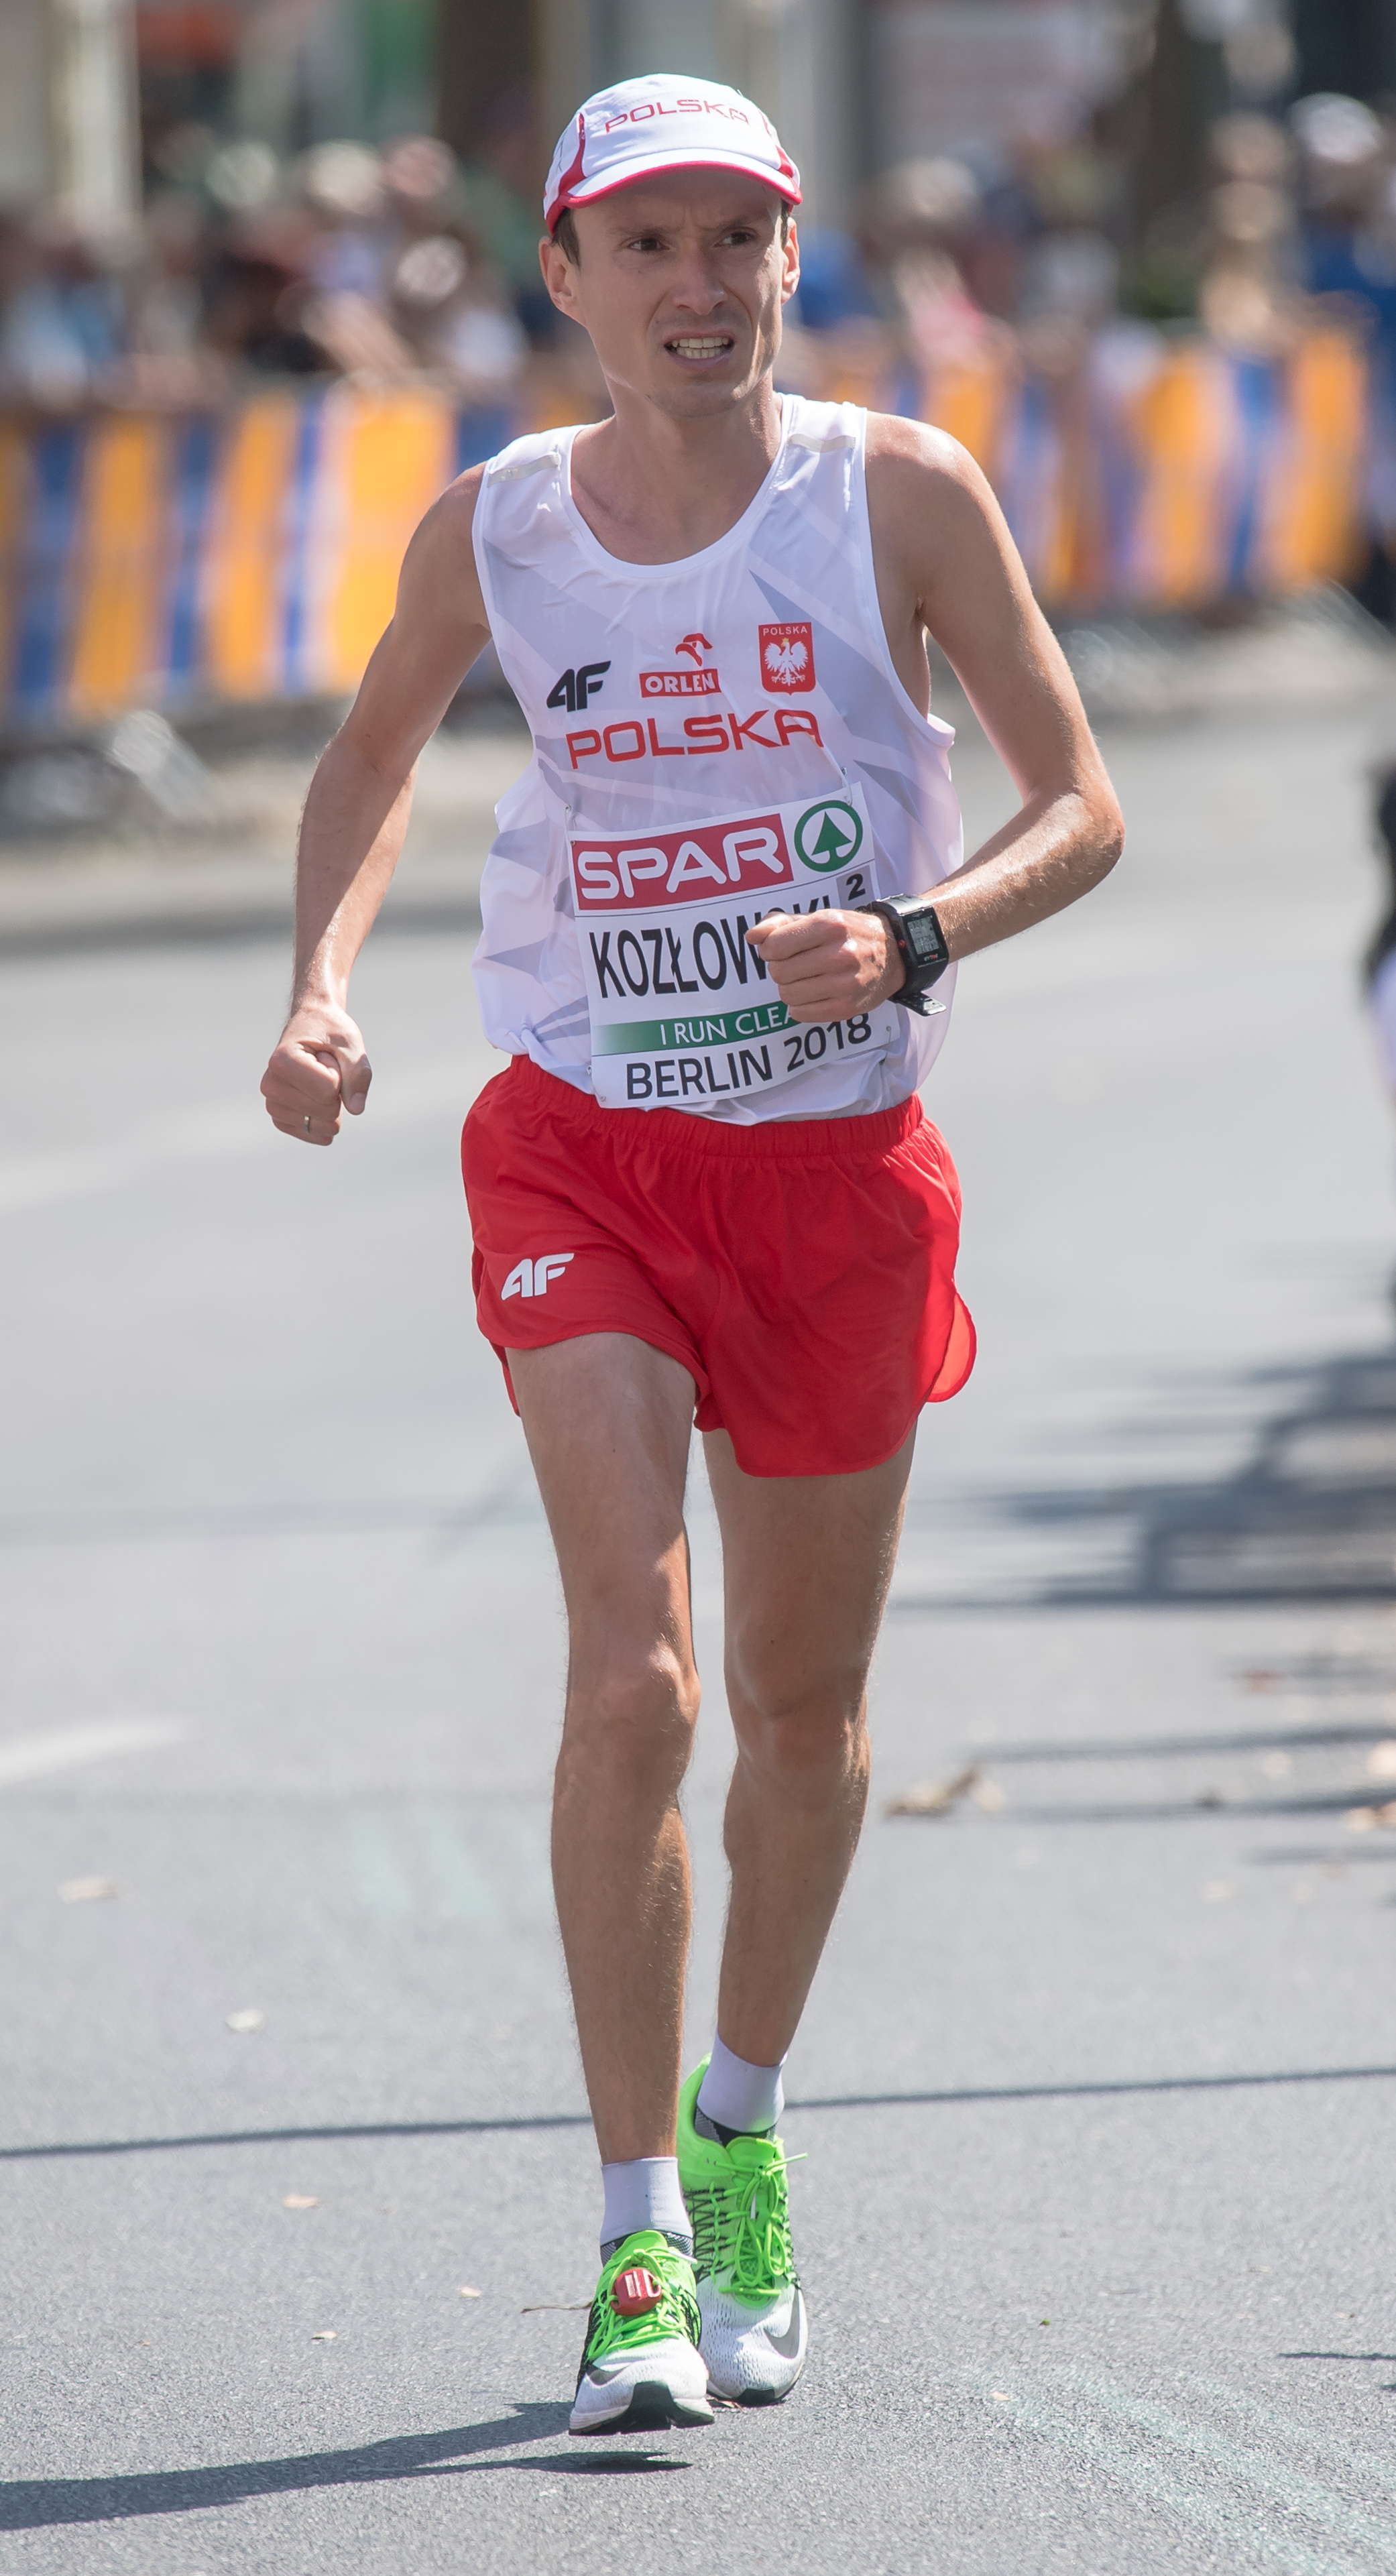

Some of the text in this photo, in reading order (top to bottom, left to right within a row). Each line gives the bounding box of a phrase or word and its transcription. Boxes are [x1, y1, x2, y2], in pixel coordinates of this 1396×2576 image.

[605, 99, 750, 133] POLSKA
[762, 625, 809, 636] POLSKA
[546, 660, 612, 713] 4F
[644, 671, 717, 694] ORLEN
[565, 708, 825, 770] POLSKA
[577, 826, 785, 900] SPAR
[845, 873, 866, 901] 2
[589, 894, 831, 998] KOZŁOW
[659, 1024, 667, 1044] I
[675, 1018, 727, 1044] RUN
[626, 1012, 872, 1101] BERLIN 2018
[500, 1252, 575, 1301] 4F
